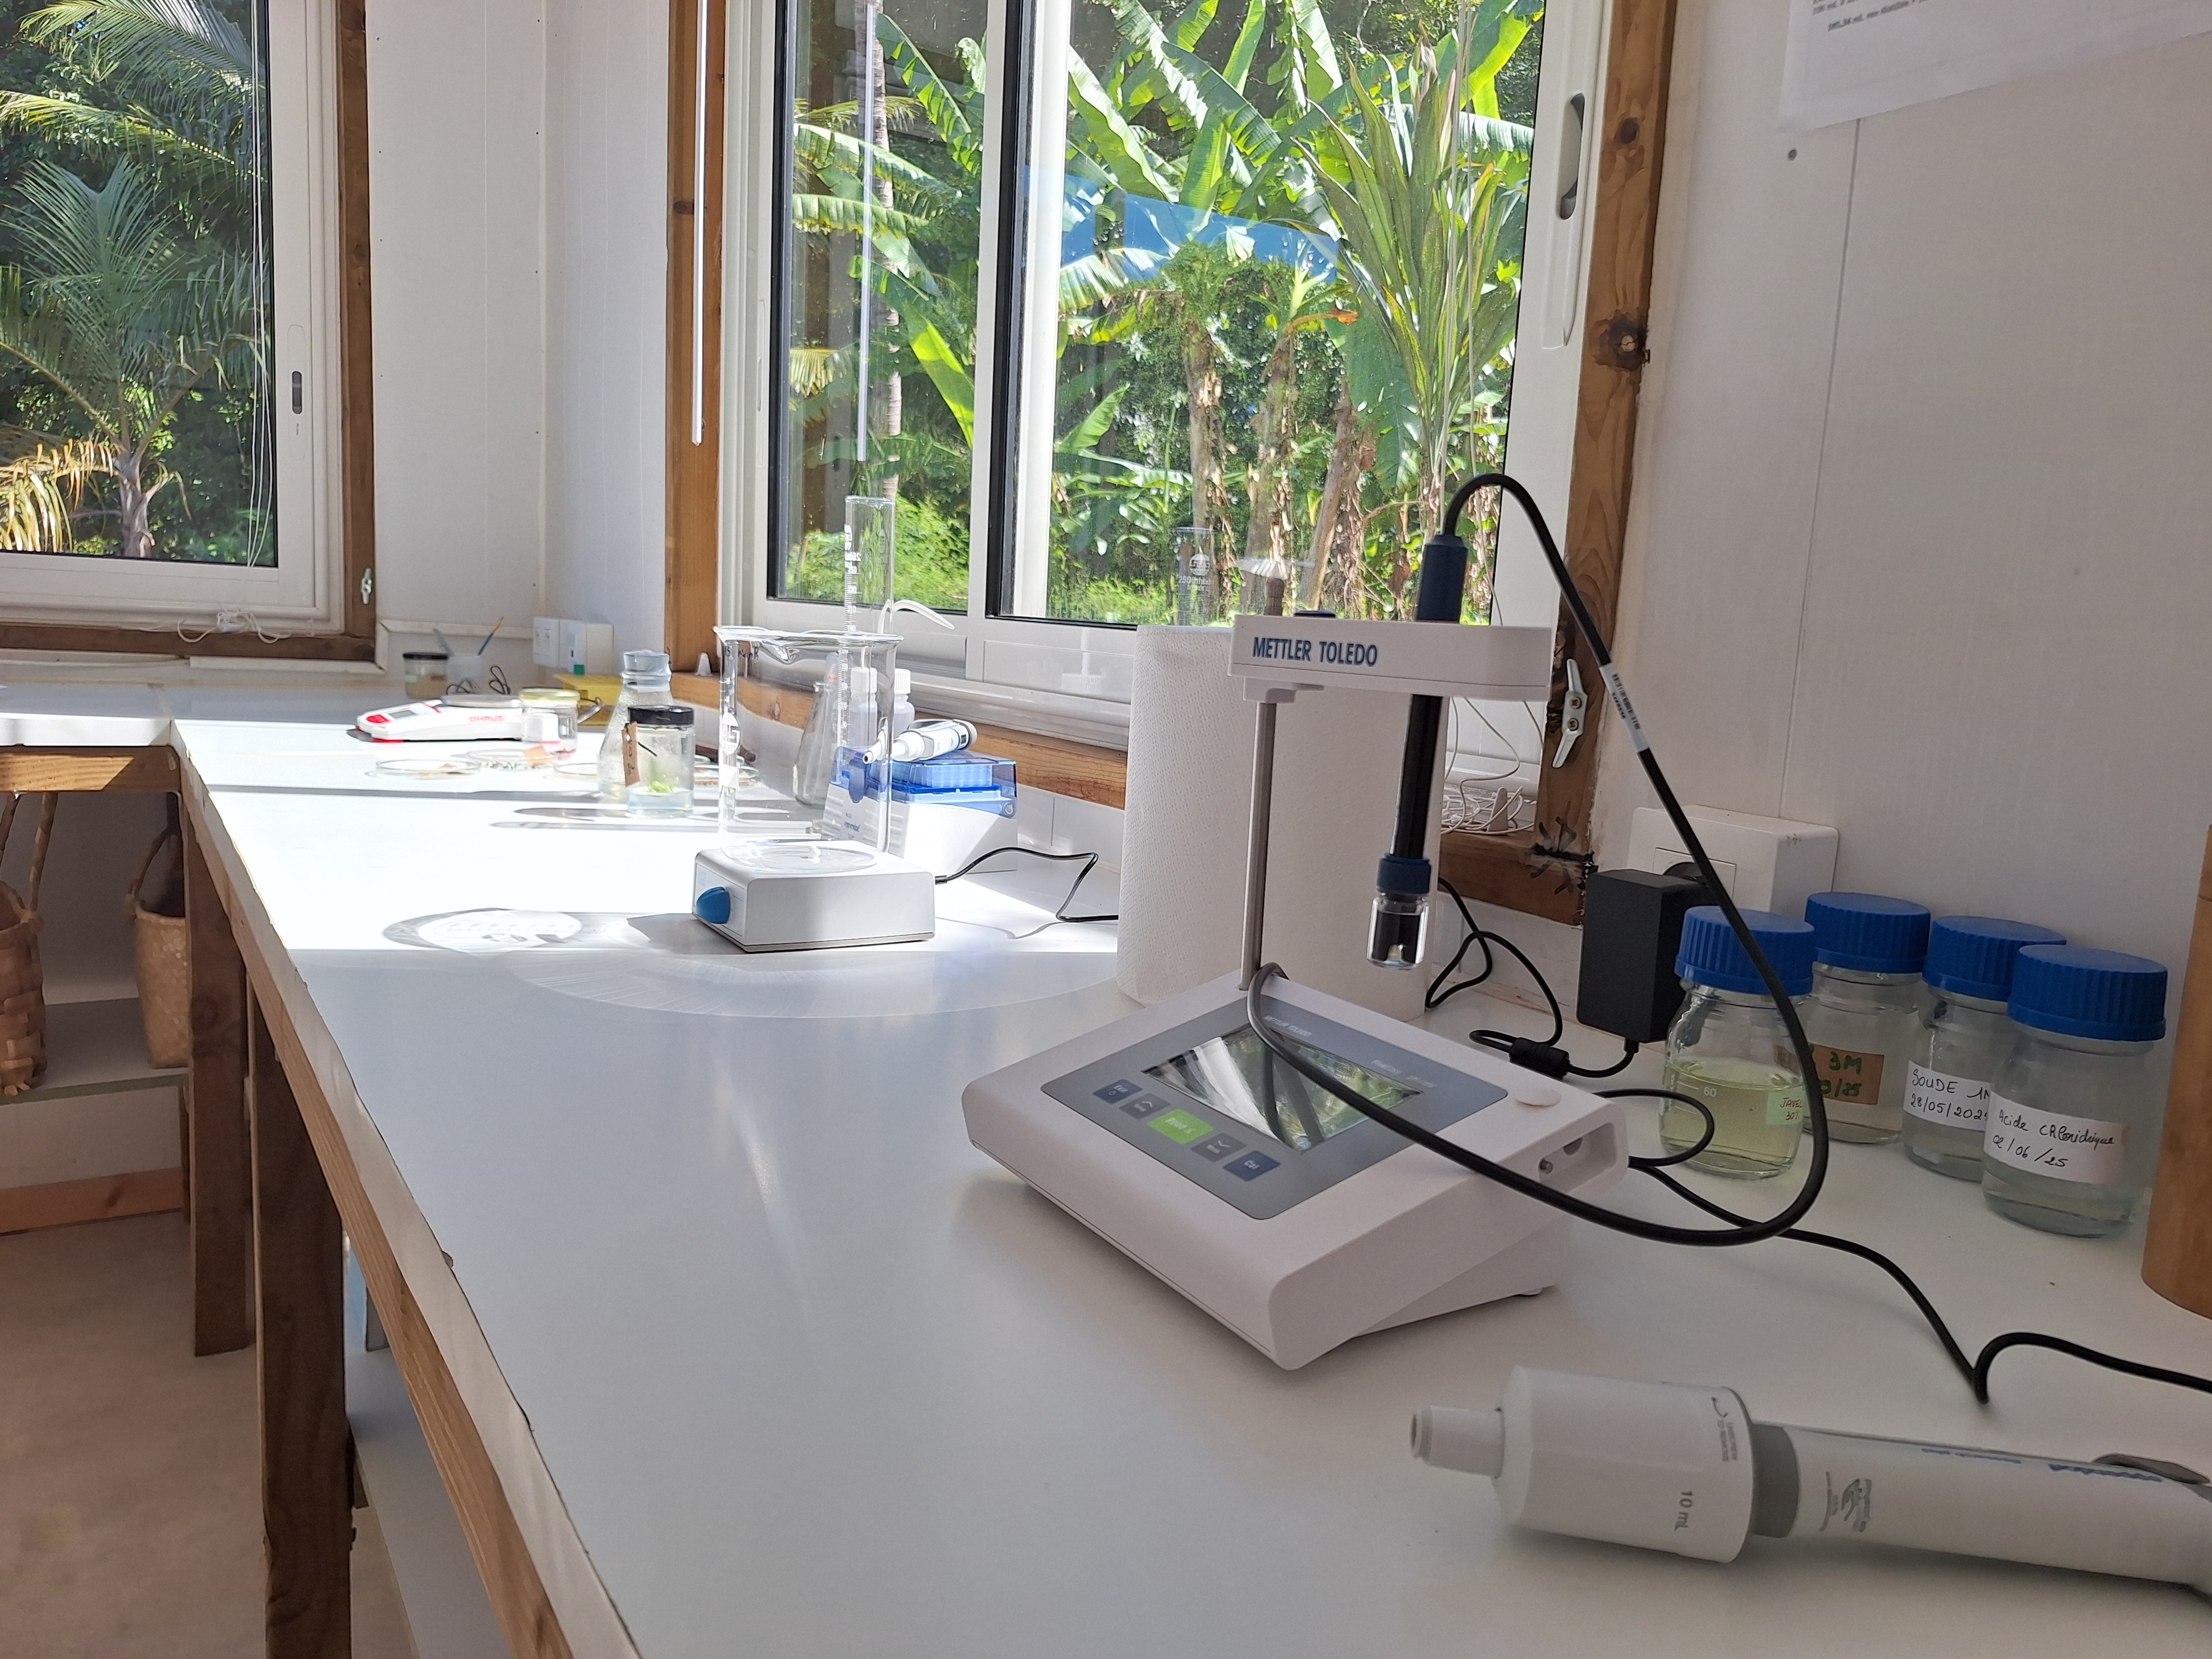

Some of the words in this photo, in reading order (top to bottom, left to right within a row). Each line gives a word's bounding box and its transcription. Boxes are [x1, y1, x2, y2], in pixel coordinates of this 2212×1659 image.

[1252, 636, 1311, 662] METTLER
[1319, 641, 1378, 667] TOLEDO
[1703, 1086, 1716, 1097] 60
[1912, 1069, 1958, 1094] SOUDE
[1999, 1109, 2028, 1131] Acide
[1243, 1160, 1260, 1170] Cal
[1679, 1490, 1693, 1508] 10
